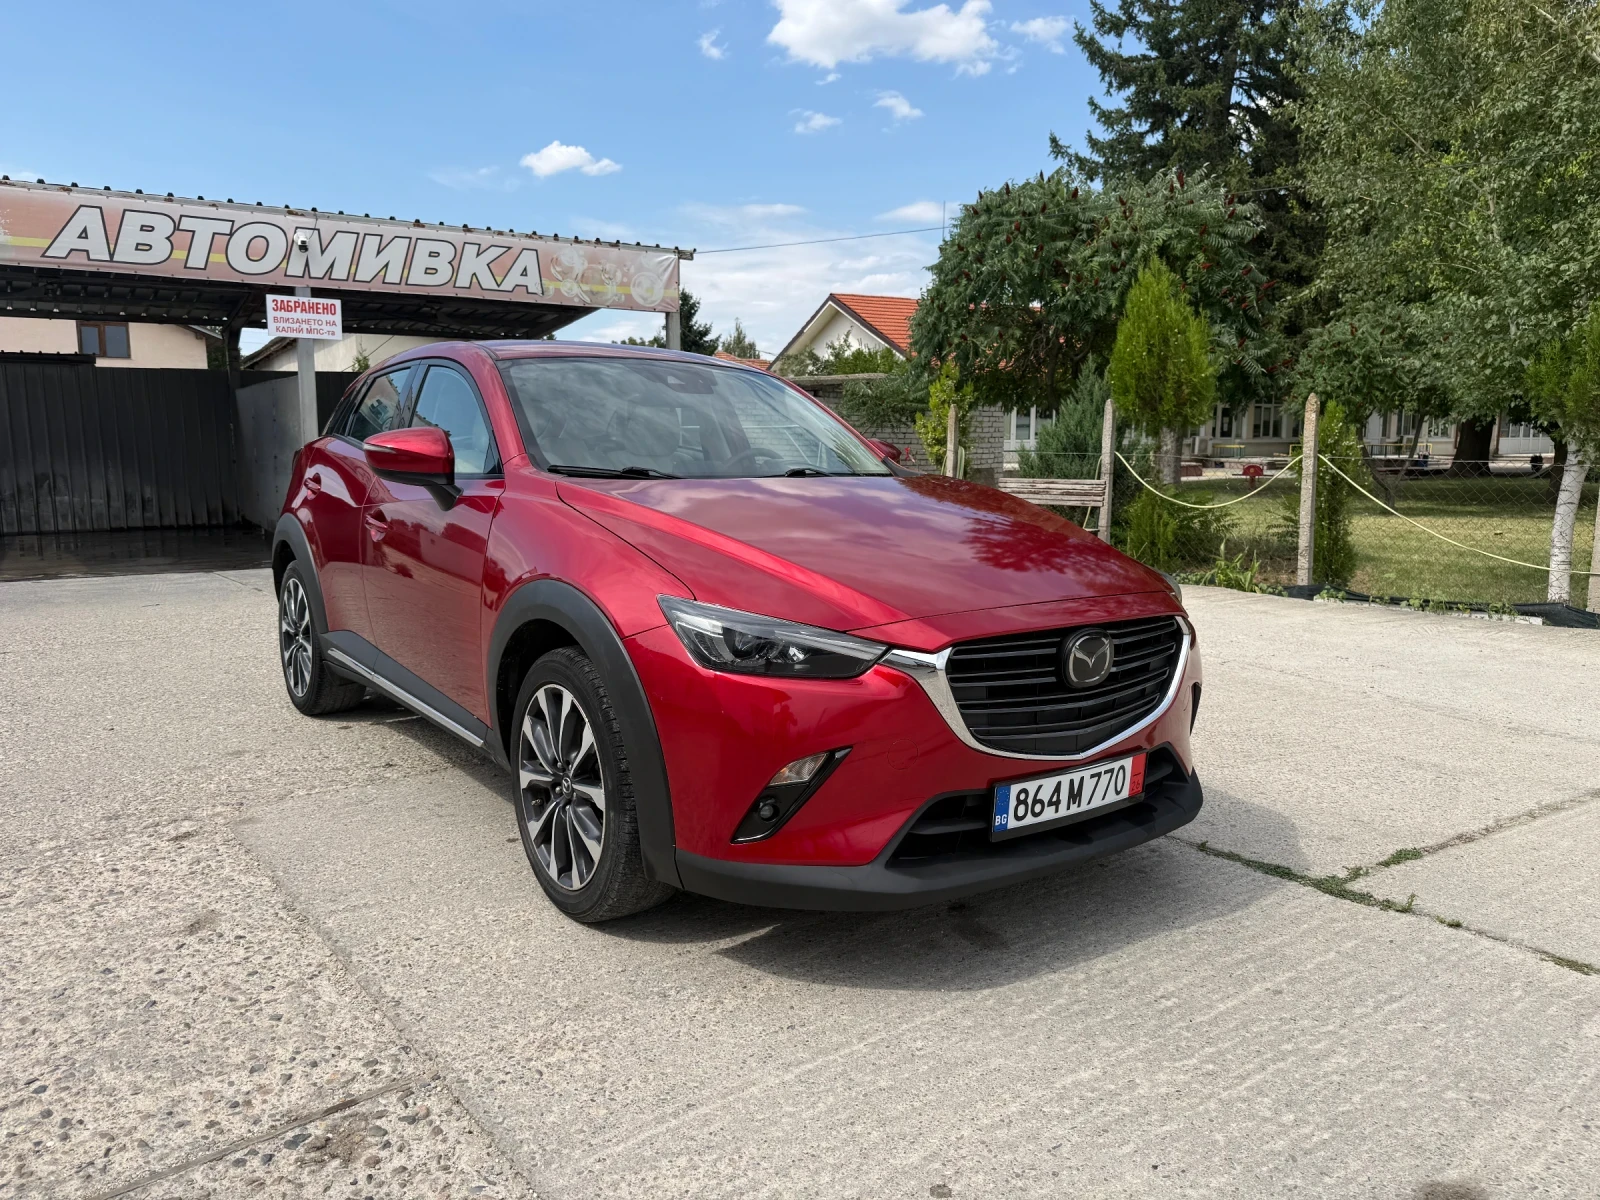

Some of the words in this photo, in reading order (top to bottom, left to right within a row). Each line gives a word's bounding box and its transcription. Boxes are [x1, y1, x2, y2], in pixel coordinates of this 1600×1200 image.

[40, 204, 544, 296] АВТОМИВКА
[272, 299, 337, 315] ЗАБРАНЕНО
[273, 316, 323, 326] ВЛИЗАНЕТО
[275, 326, 304, 334] КАЛНИ
[306, 328, 336, 336] МПС-та
[995, 814, 1007, 825] BG
